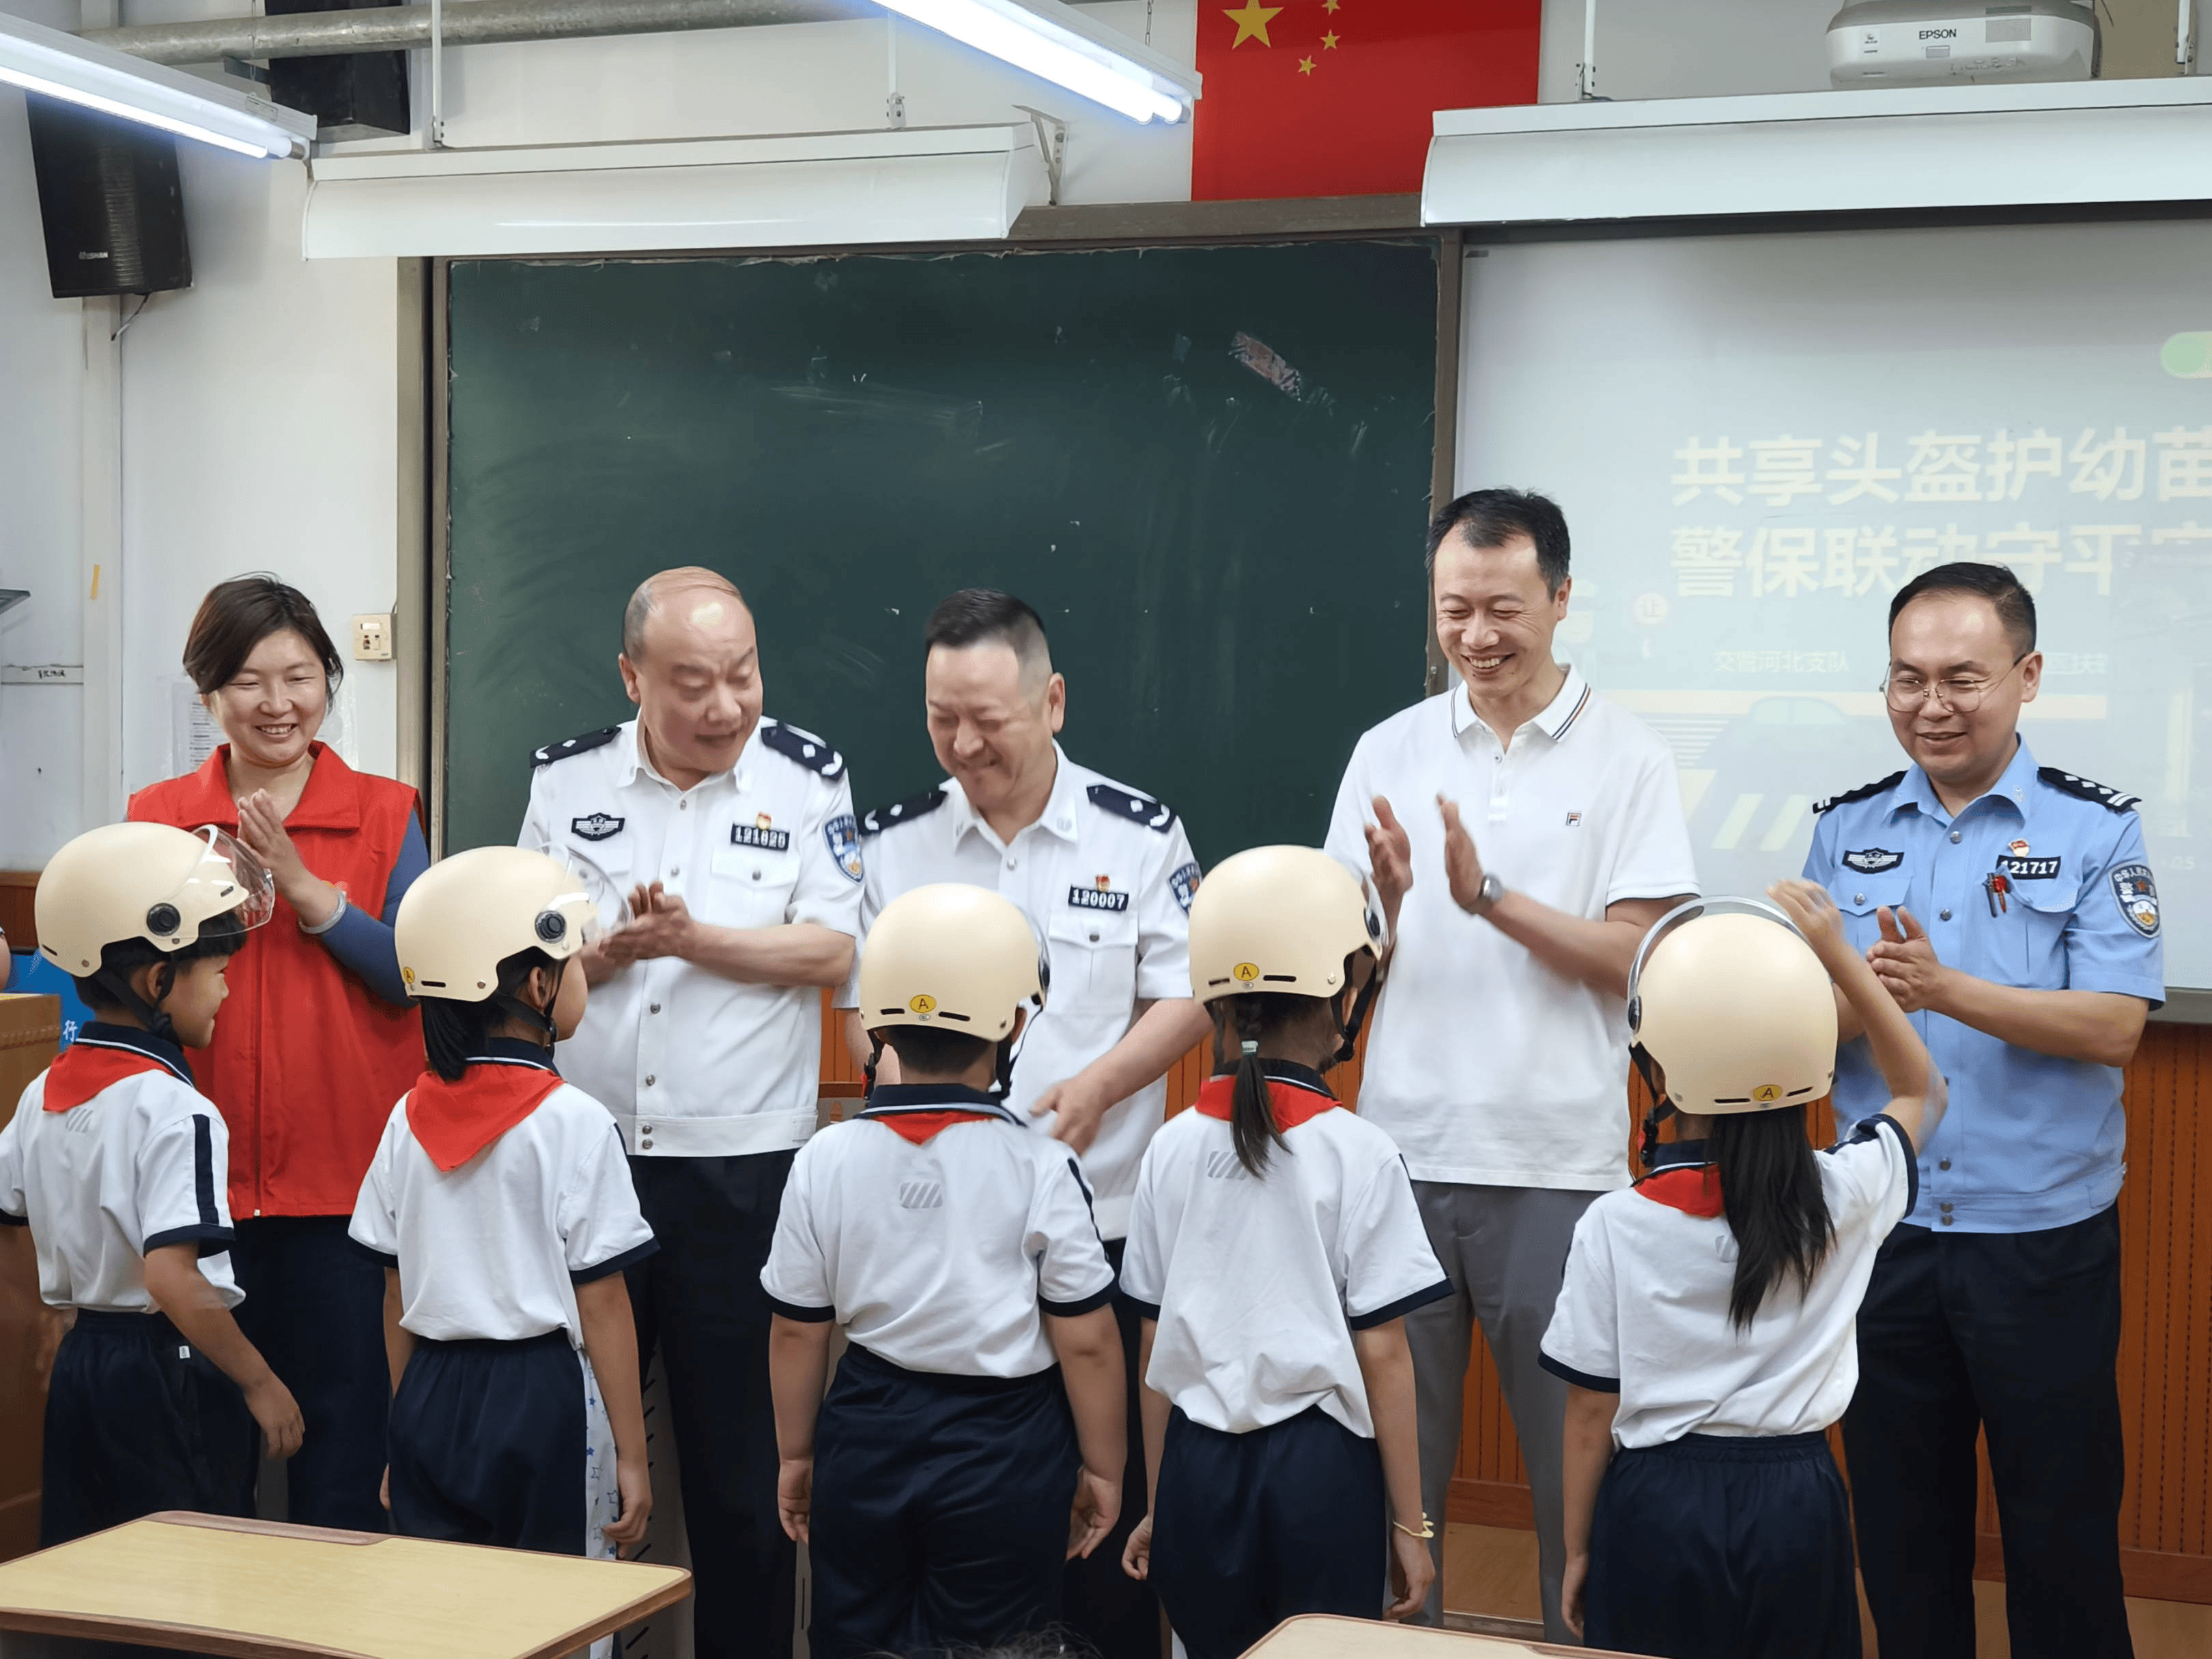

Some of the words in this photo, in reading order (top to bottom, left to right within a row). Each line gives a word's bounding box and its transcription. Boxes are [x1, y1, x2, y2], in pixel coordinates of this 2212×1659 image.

[1918, 29, 1957, 40] EPSON
[1671, 425, 2212, 508] 共享头盔护幼苗
[1072, 888, 1125, 909] 120007
[1241, 966, 1251, 978] A
[918, 998, 929, 1010] A
[1761, 1087, 1774, 1098] A
